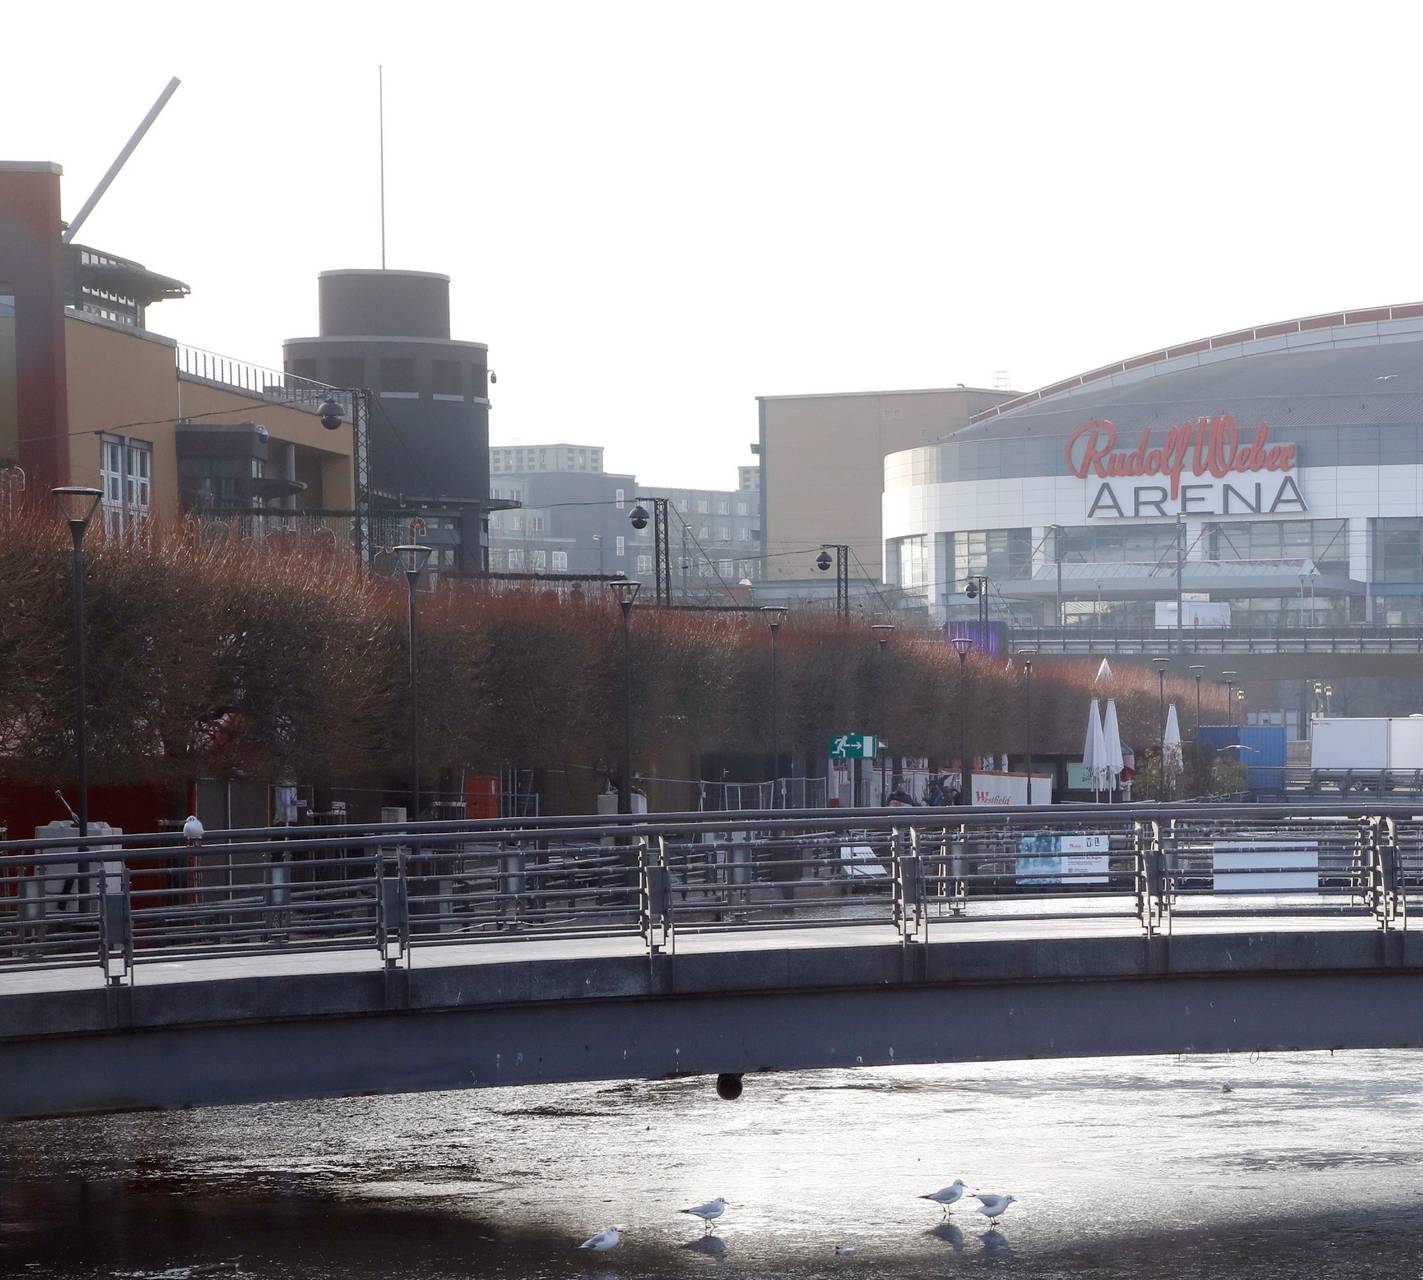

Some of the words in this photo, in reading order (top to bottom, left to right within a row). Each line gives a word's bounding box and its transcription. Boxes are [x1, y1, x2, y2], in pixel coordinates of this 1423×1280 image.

[1064, 419, 1193, 500] Rudolf
[1192, 411, 1296, 478] Weber
[1087, 475, 1309, 518] ARENA
